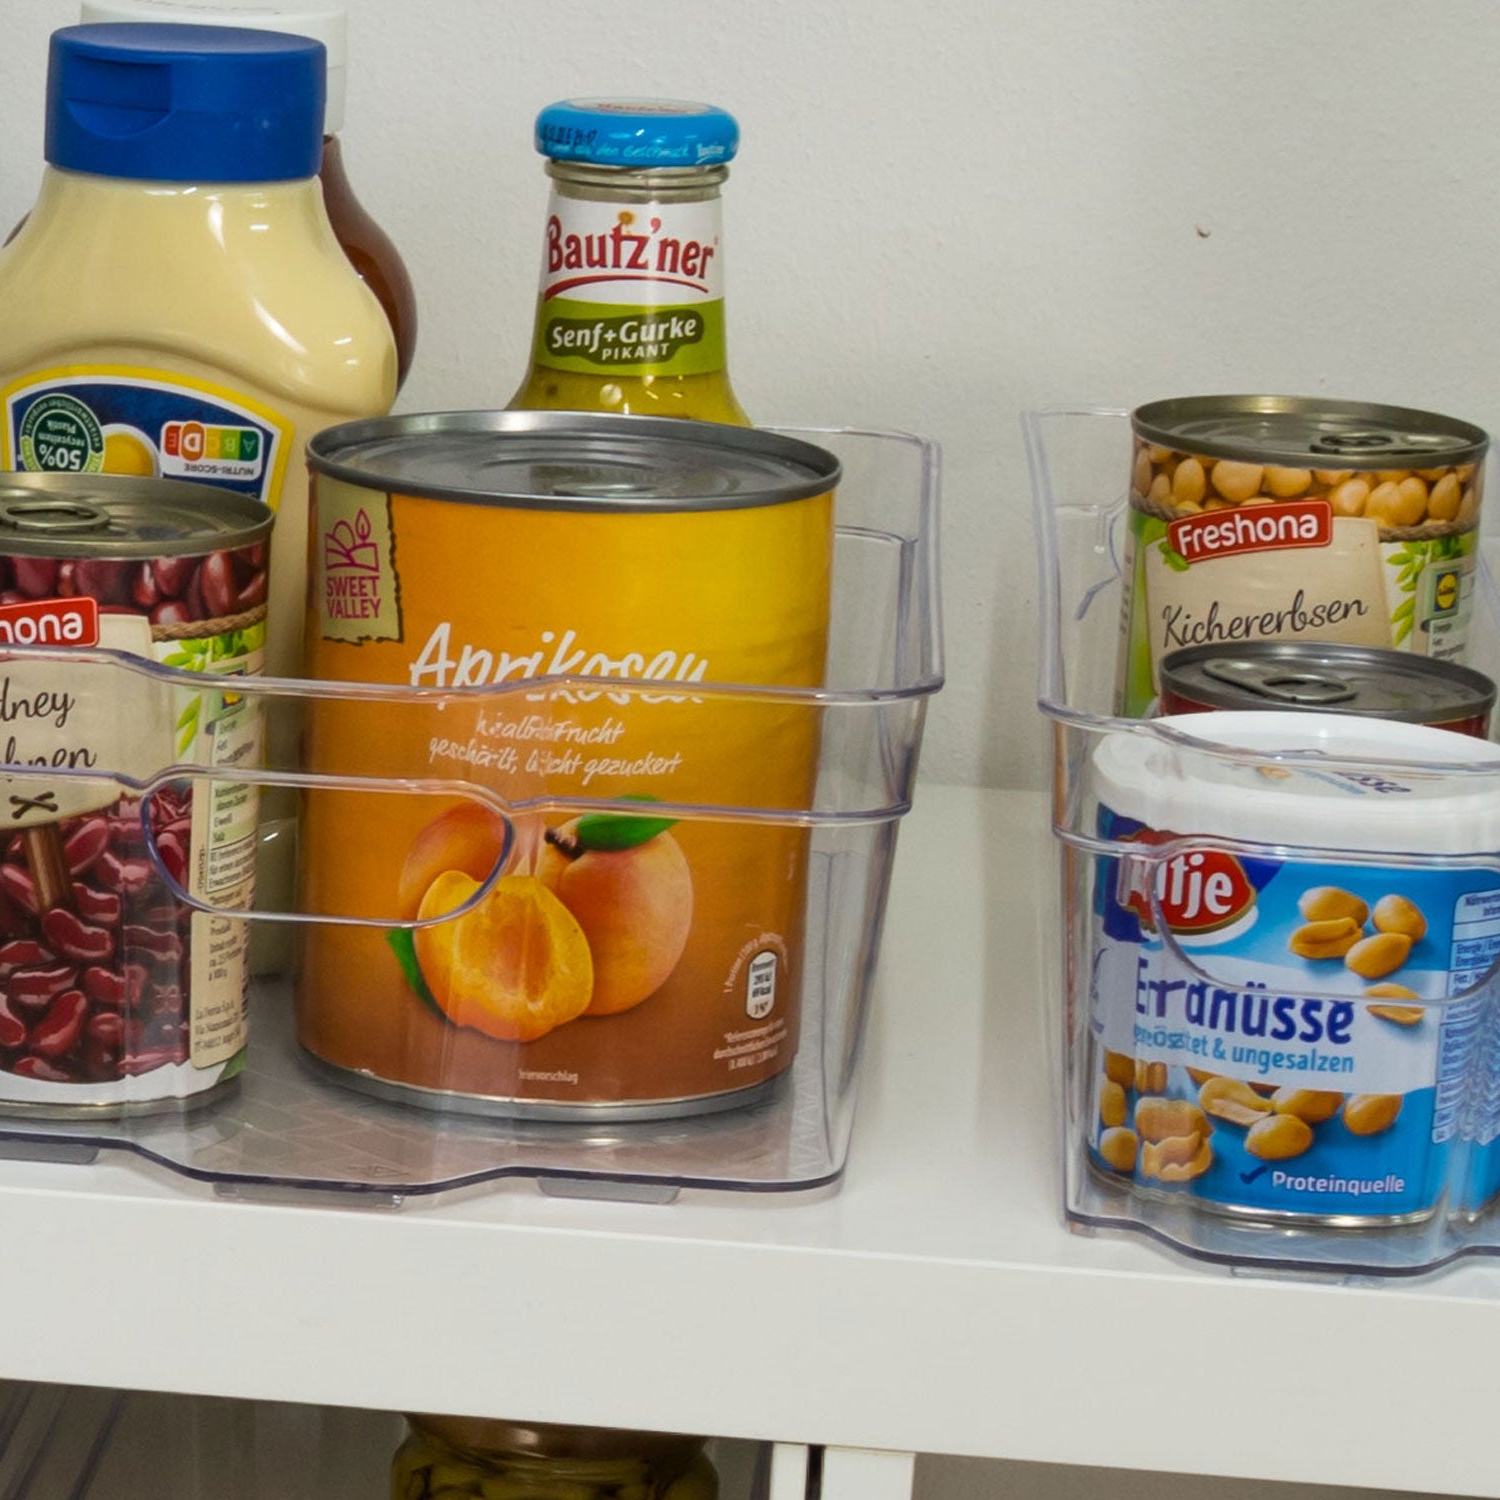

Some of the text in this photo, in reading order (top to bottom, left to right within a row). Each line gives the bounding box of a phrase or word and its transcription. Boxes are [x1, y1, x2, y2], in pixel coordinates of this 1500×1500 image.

[551, 316, 698, 354] Senf+Gurke
[602, 343, 670, 361] PIKANT
[39, 444, 82, 471] 50%
[184, 462, 256, 477] NUTRI-SCORE
[1177, 513, 1320, 557] Freshona
[326, 575, 380, 597] SWEET
[327, 598, 381, 618] VALLEY
[1161, 590, 1369, 648] Kichererbsen
[550, 717, 626, 745] Frucht
[581, 751, 683, 786] gezuckert
[1213, 1037, 1227, 1061] &
[1231, 1045, 1355, 1074] ungesalzen
[1272, 1171, 1405, 1197] Proteinquelle
